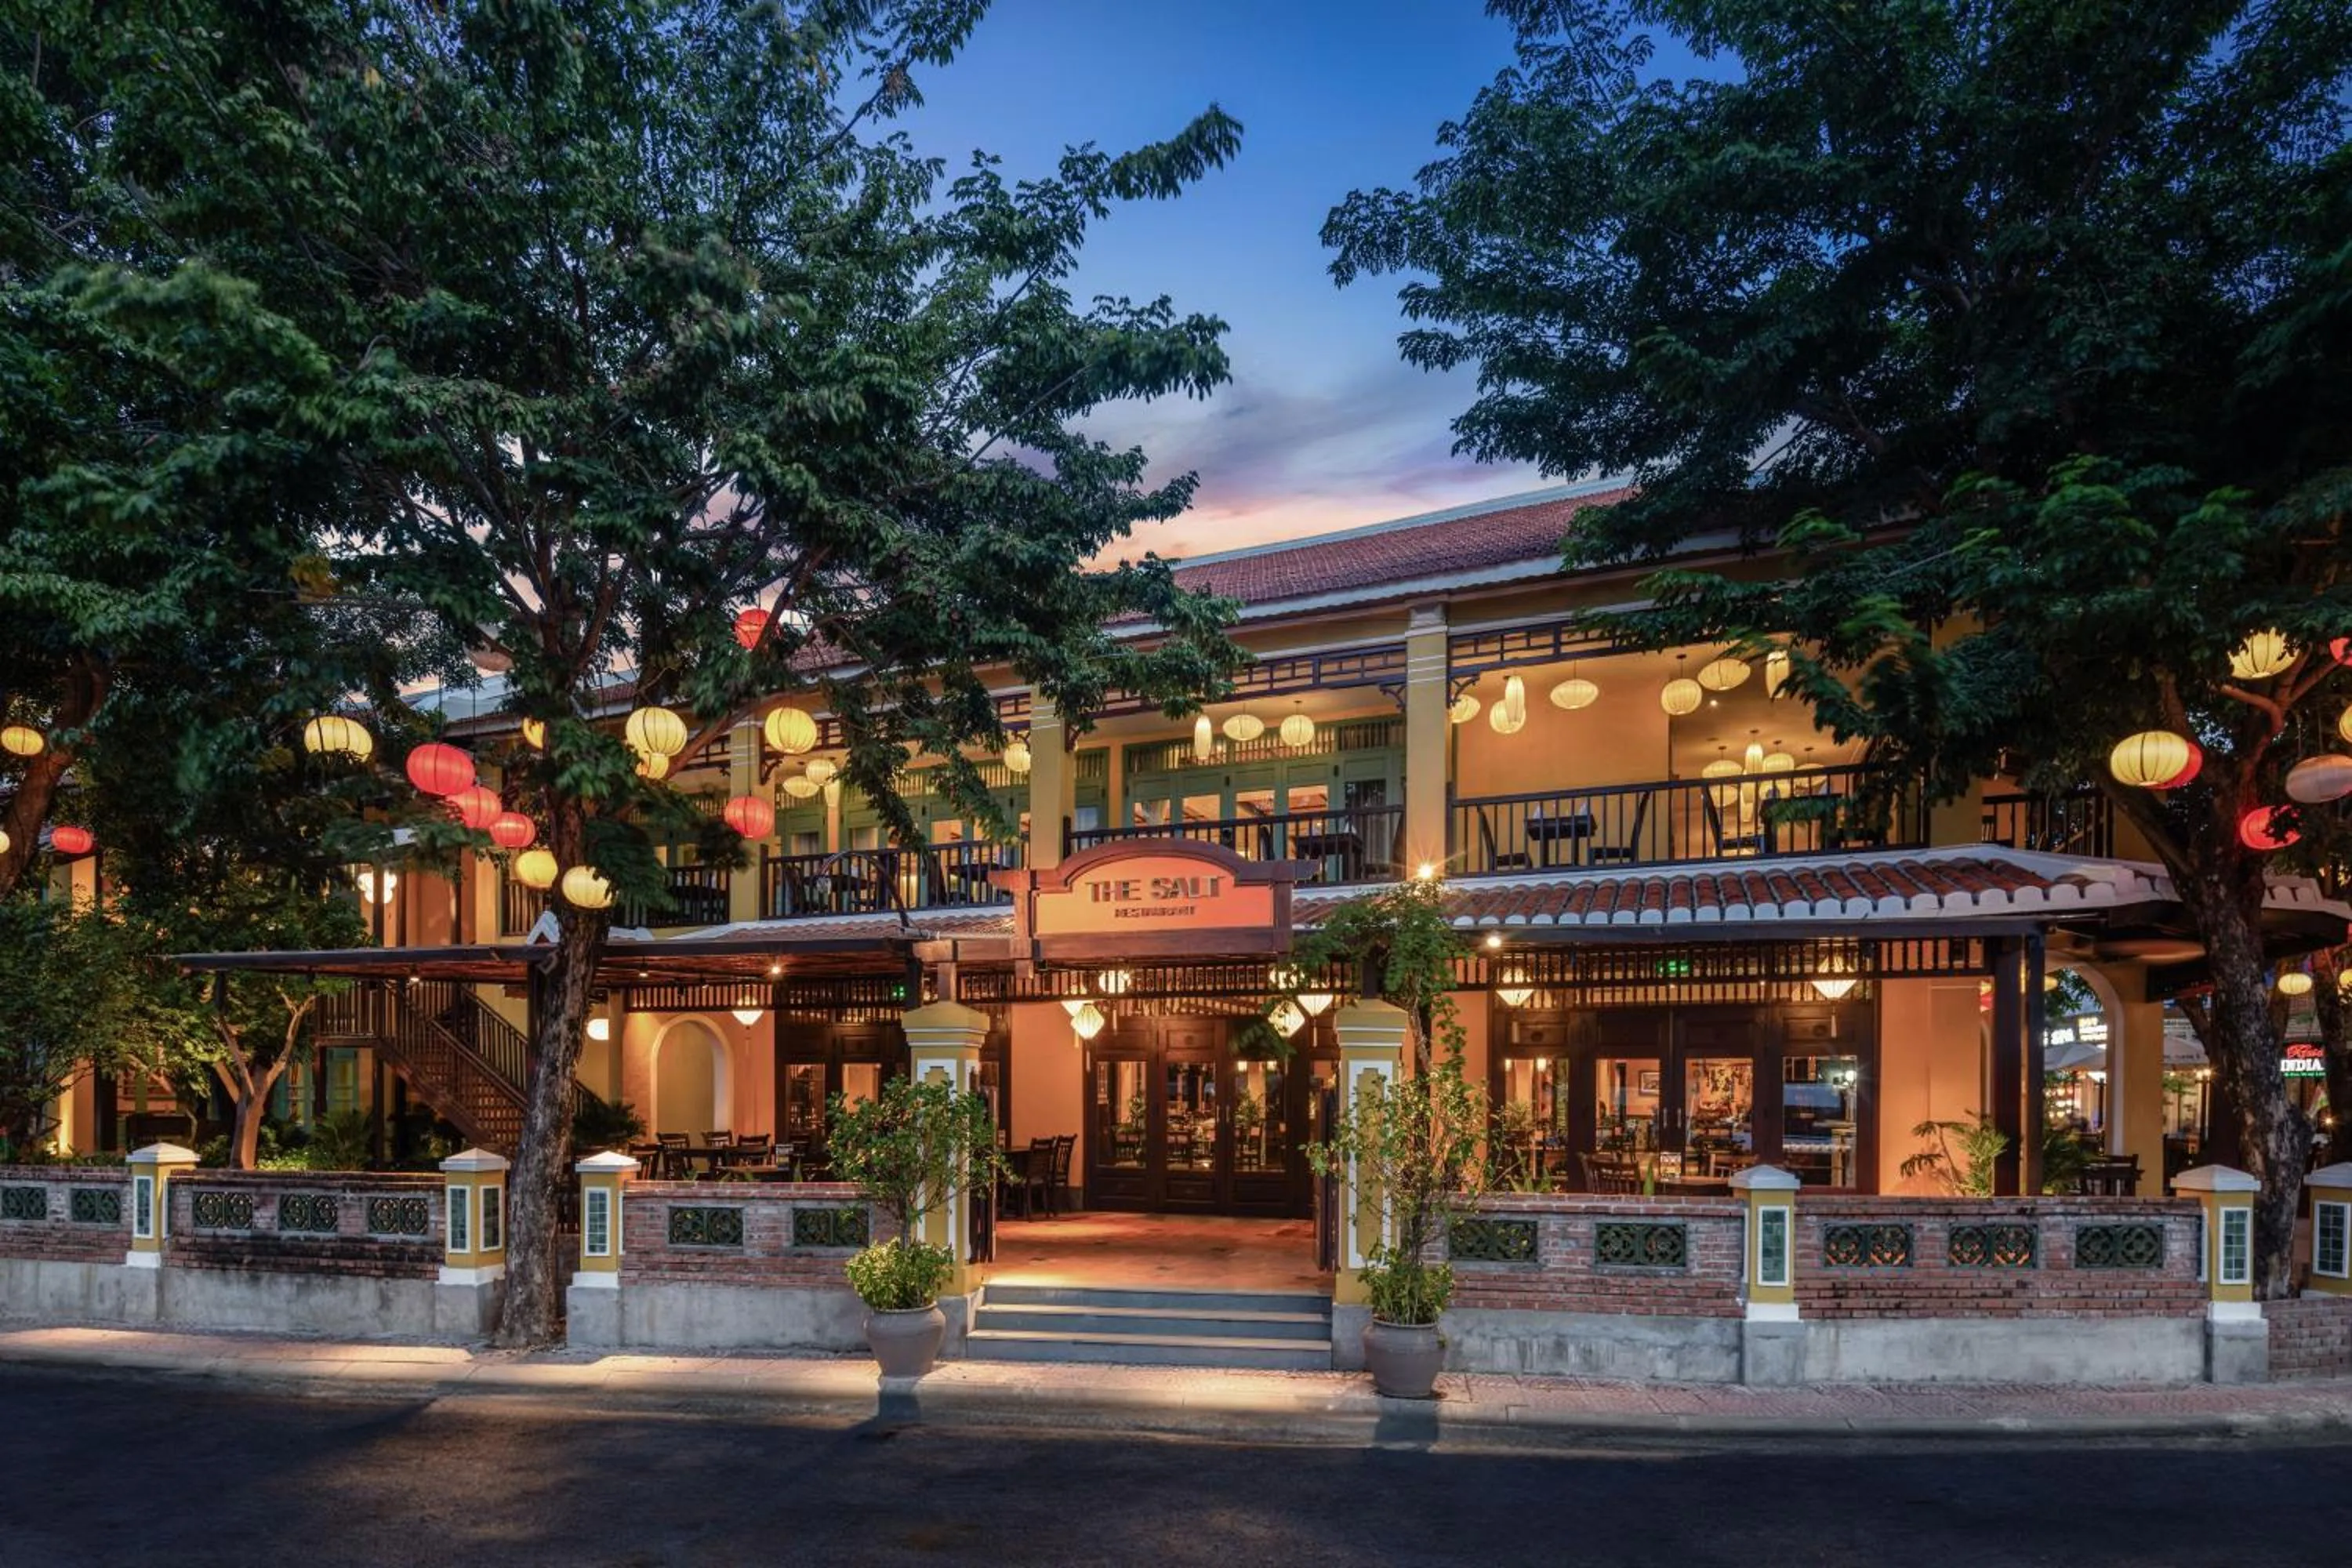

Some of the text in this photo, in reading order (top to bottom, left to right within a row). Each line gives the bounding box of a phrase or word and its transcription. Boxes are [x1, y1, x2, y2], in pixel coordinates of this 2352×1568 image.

[1085, 876, 1225, 902] THE SALT
[1114, 906, 1196, 918] RESTAURANT
